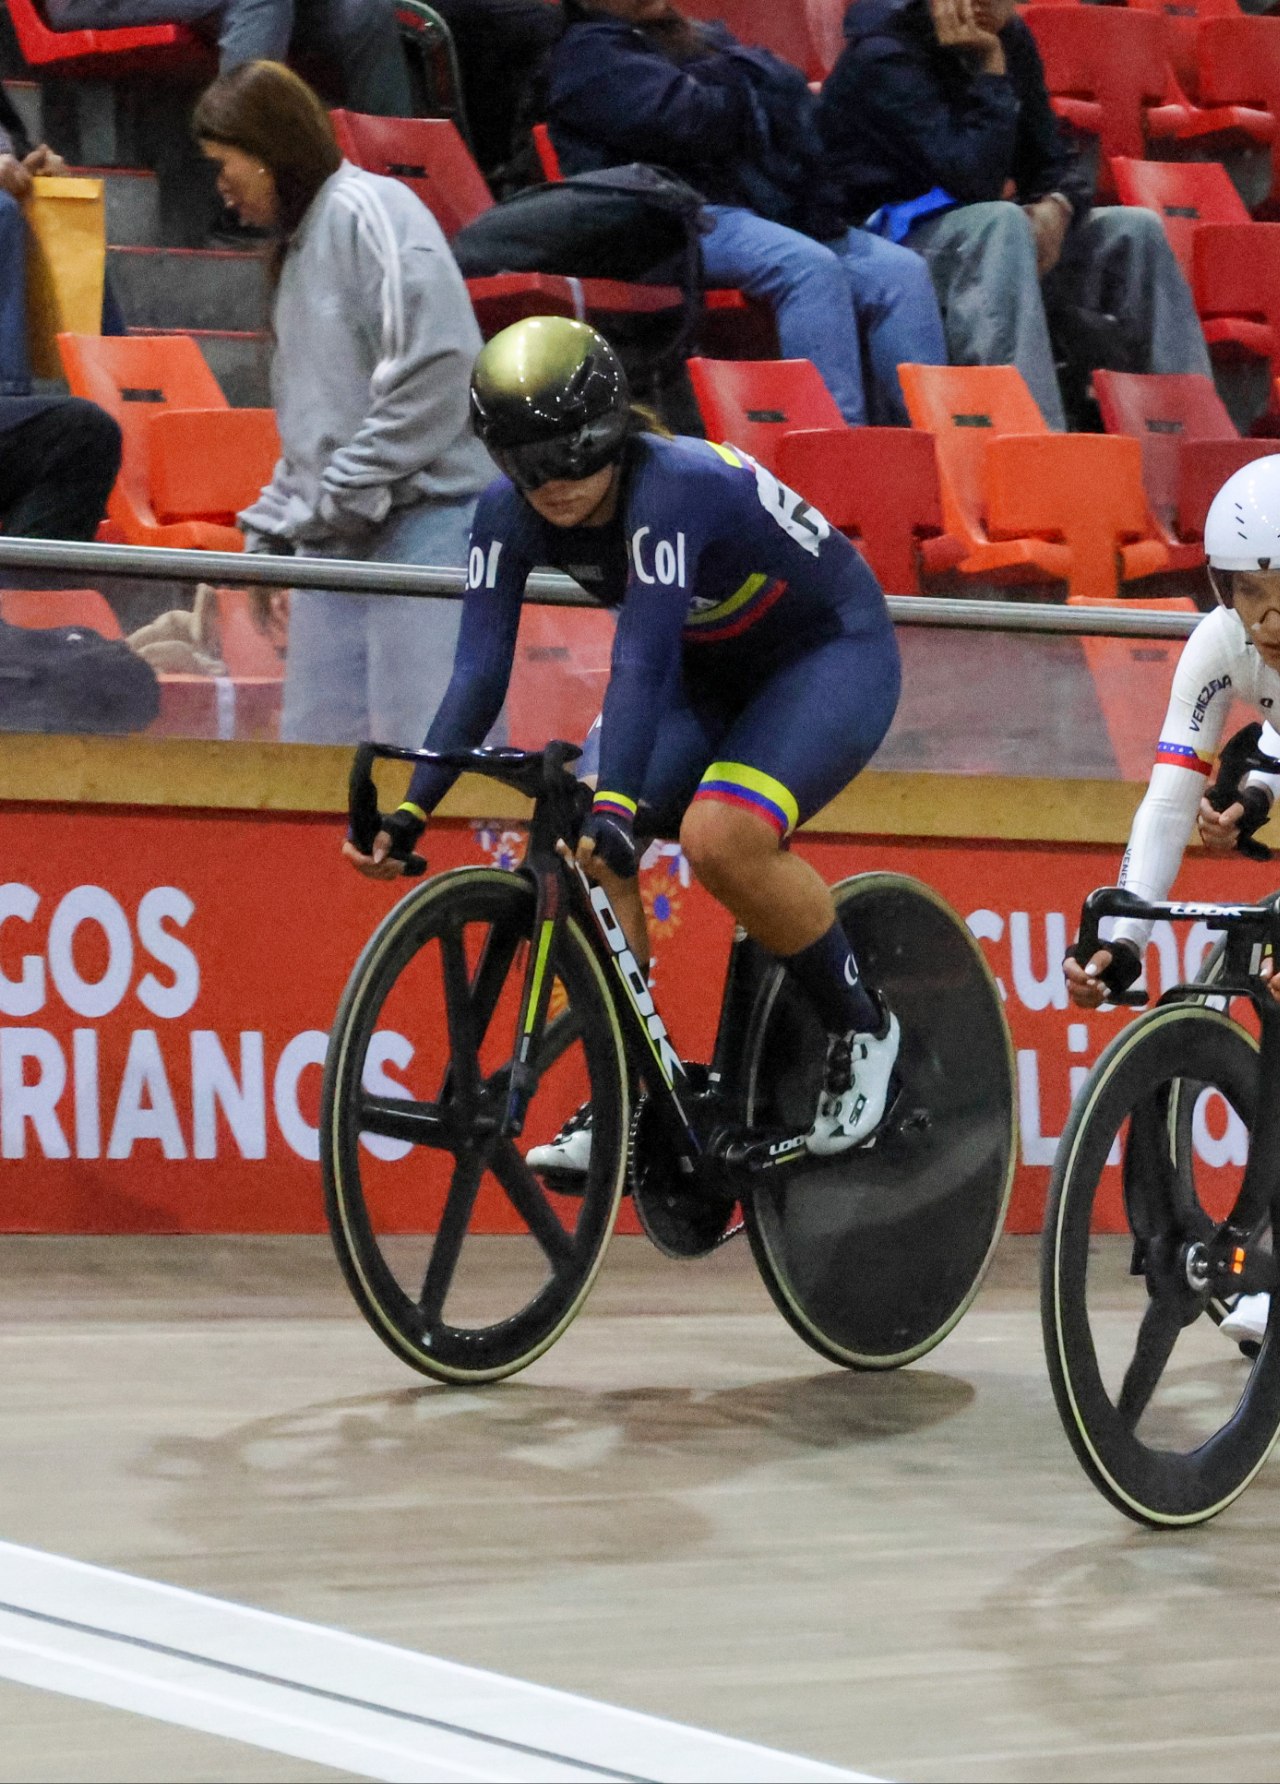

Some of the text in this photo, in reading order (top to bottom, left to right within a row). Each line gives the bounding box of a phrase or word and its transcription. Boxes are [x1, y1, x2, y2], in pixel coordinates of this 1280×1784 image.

[465, 532, 503, 591] ol
[632, 525, 686, 588] Col
[1170, 904, 1242, 917] LOOK
[0, 882, 200, 1019] GOS
[0, 1026, 415, 1162] RIANOS
